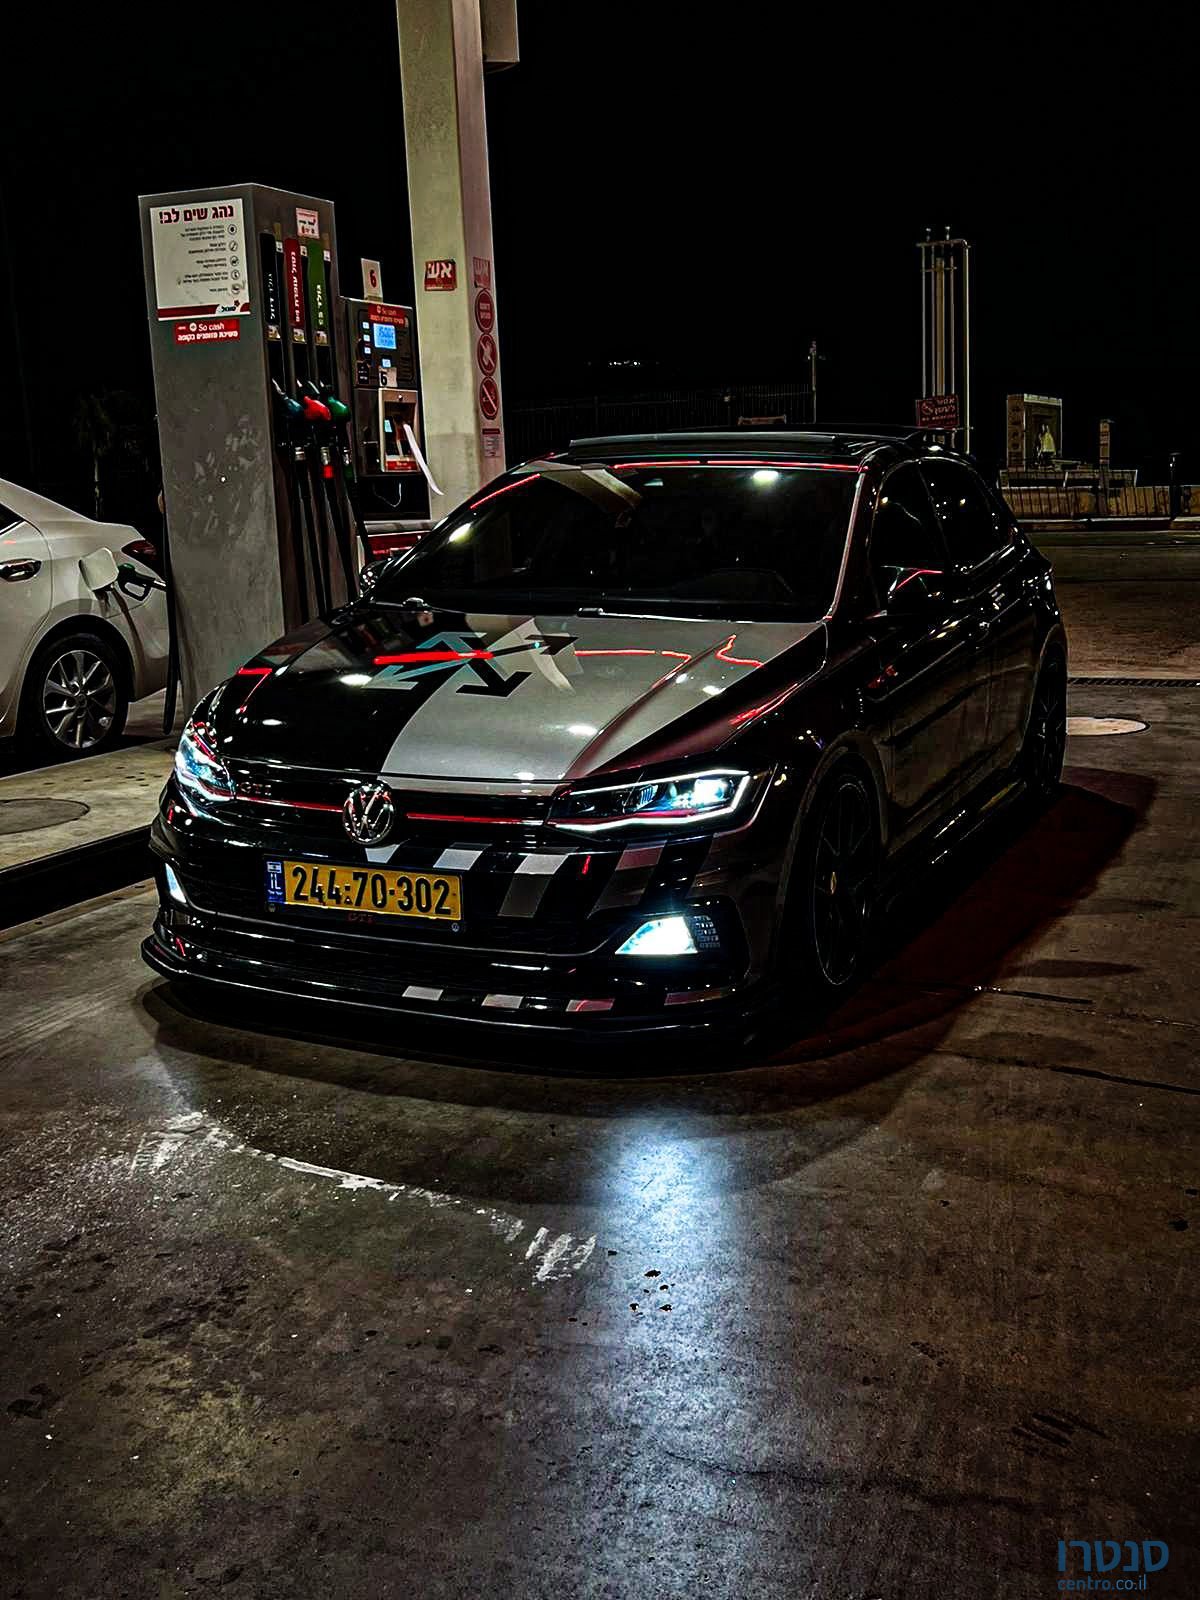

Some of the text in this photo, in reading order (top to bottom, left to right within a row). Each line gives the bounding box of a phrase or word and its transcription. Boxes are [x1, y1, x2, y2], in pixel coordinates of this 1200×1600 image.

[159, 205, 234, 224] נהג שים לב!
[427, 262, 452, 278] אש
[369, 269, 377, 288] 6
[198, 322, 225, 331] So cash
[219, 330, 238, 338] משיכת
[380, 370, 388, 386] 6
[270, 873, 282, 890] IL
